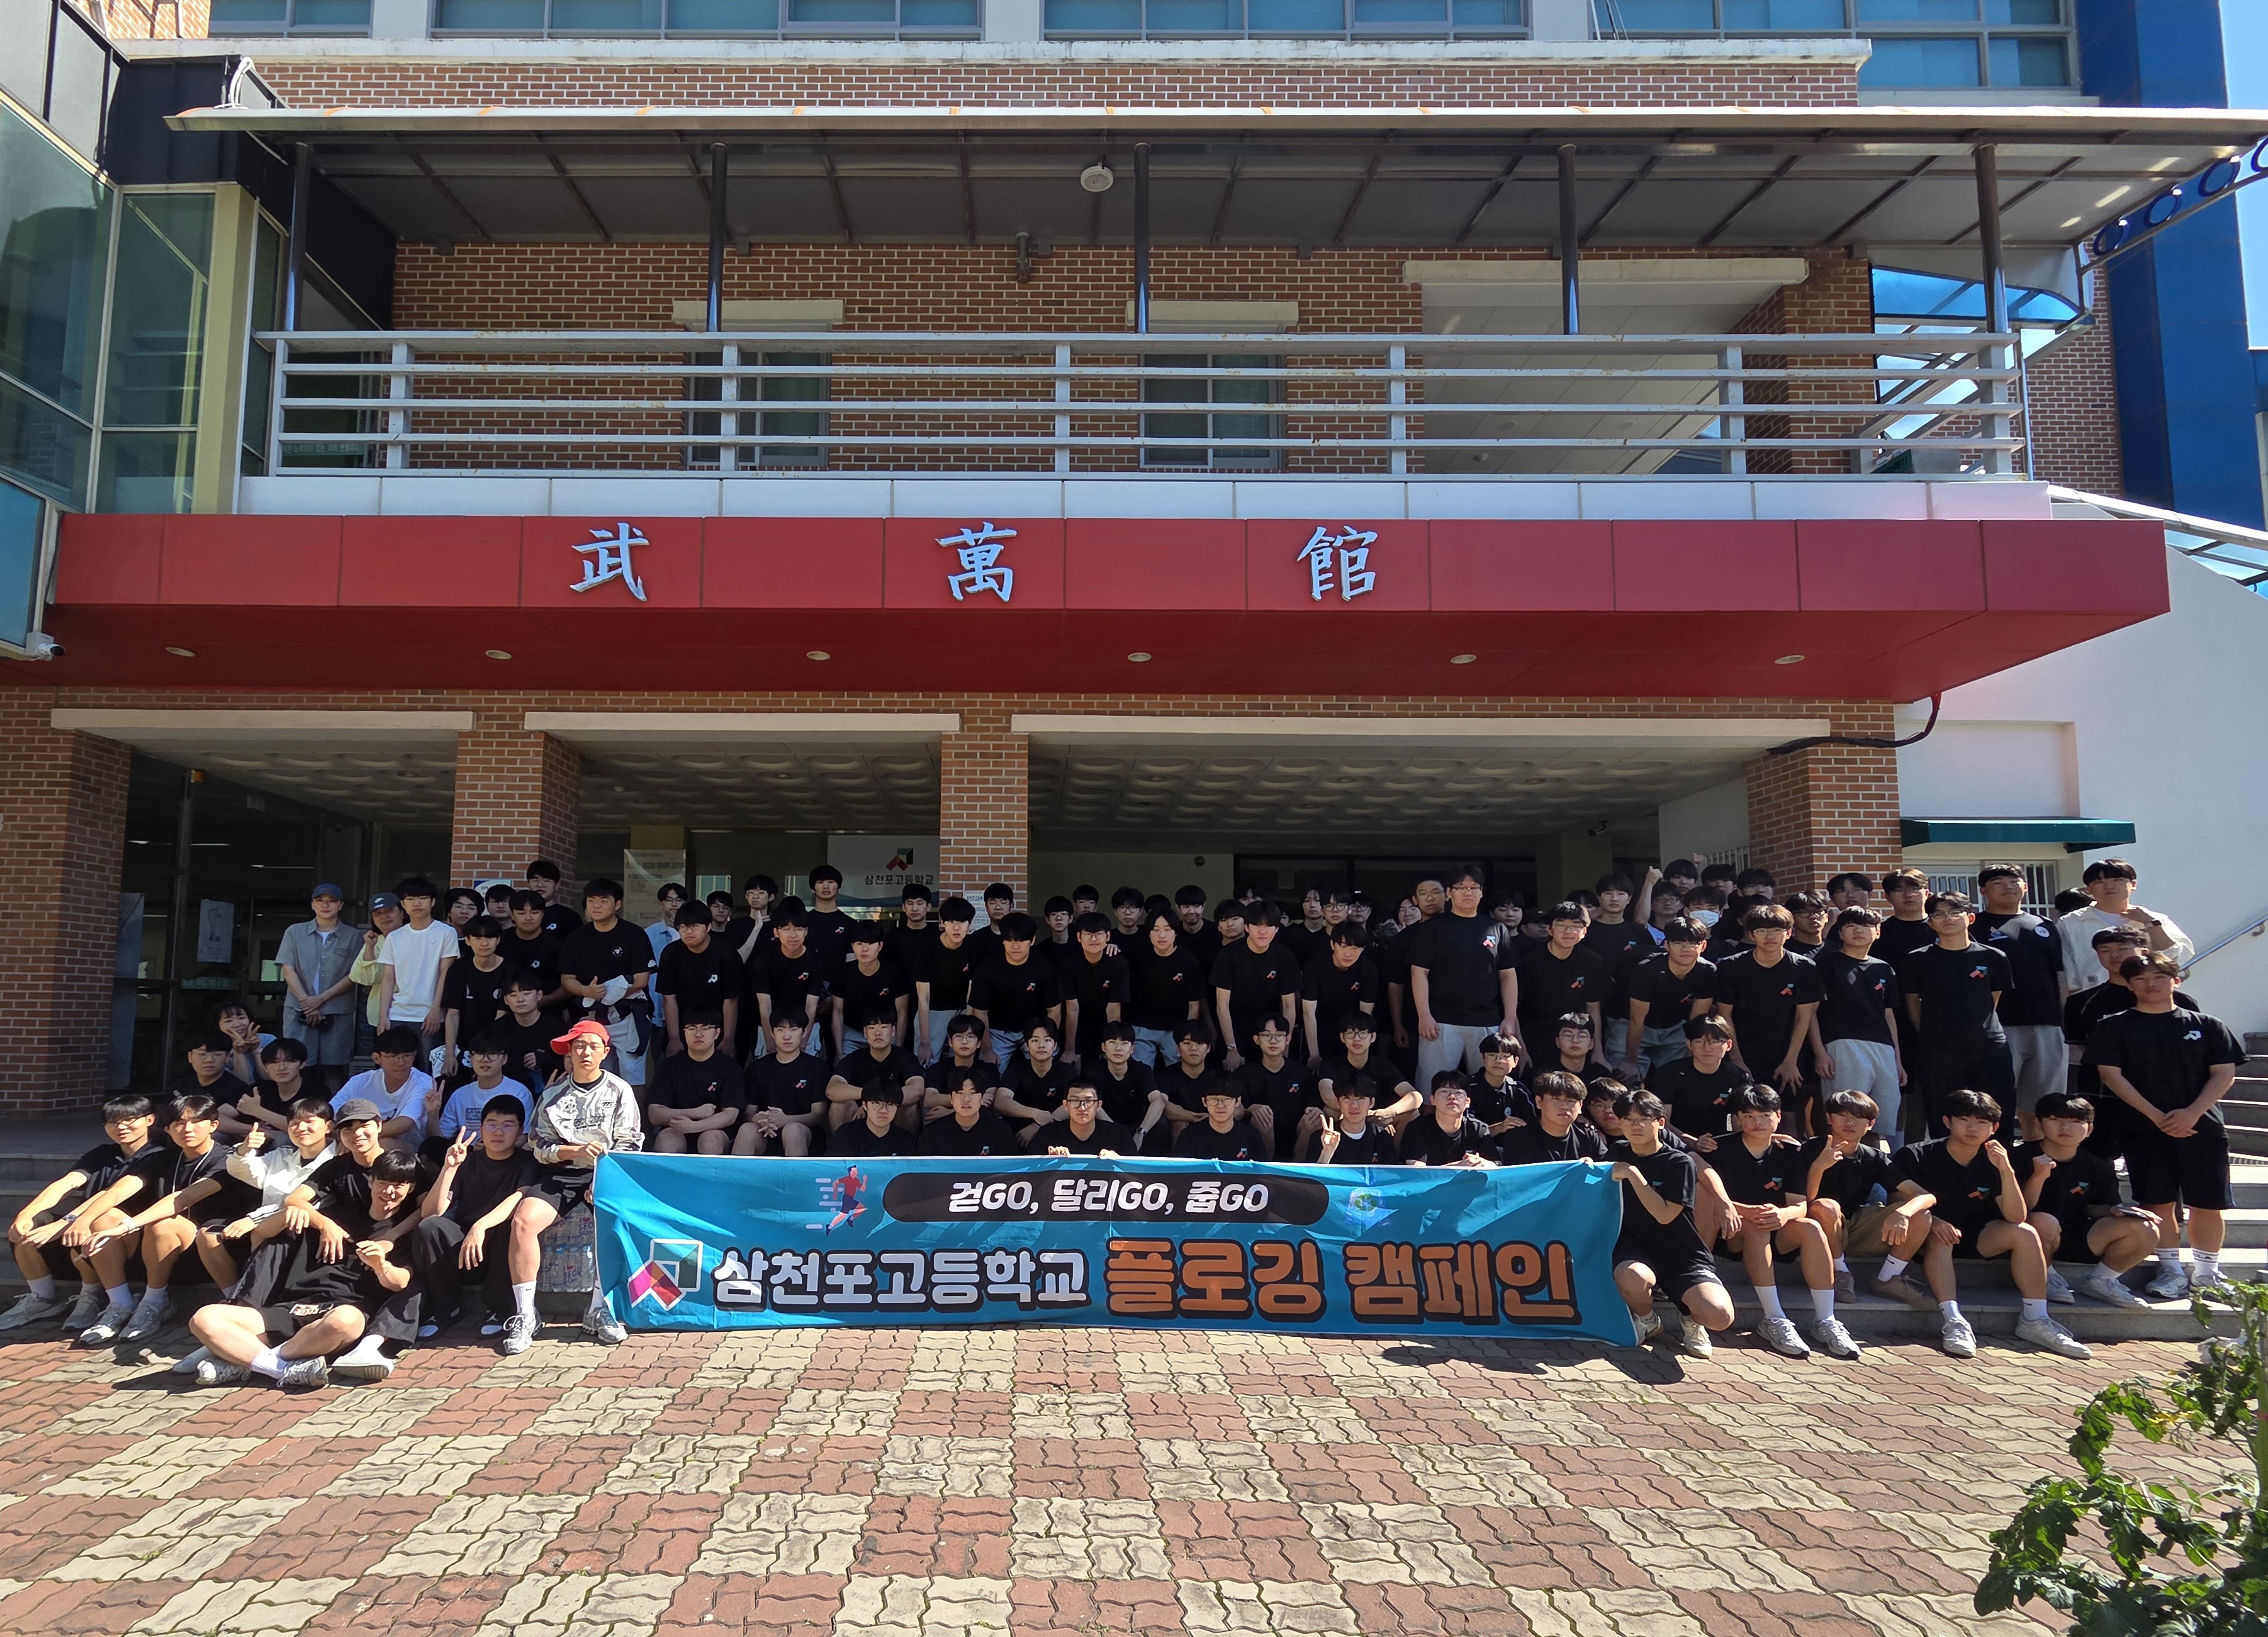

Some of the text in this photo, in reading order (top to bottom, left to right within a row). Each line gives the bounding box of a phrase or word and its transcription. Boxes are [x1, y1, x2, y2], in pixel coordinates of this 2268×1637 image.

[570, 522, 1378, 603] 武萬館
[865, 874, 935, 885] 삼천포고등학교
[949, 1178, 1269, 1215] 걷GO, 달리GO, 줍GO
[713, 1240, 1576, 1319] 삼천포고등학교 플로깅 캠페인
